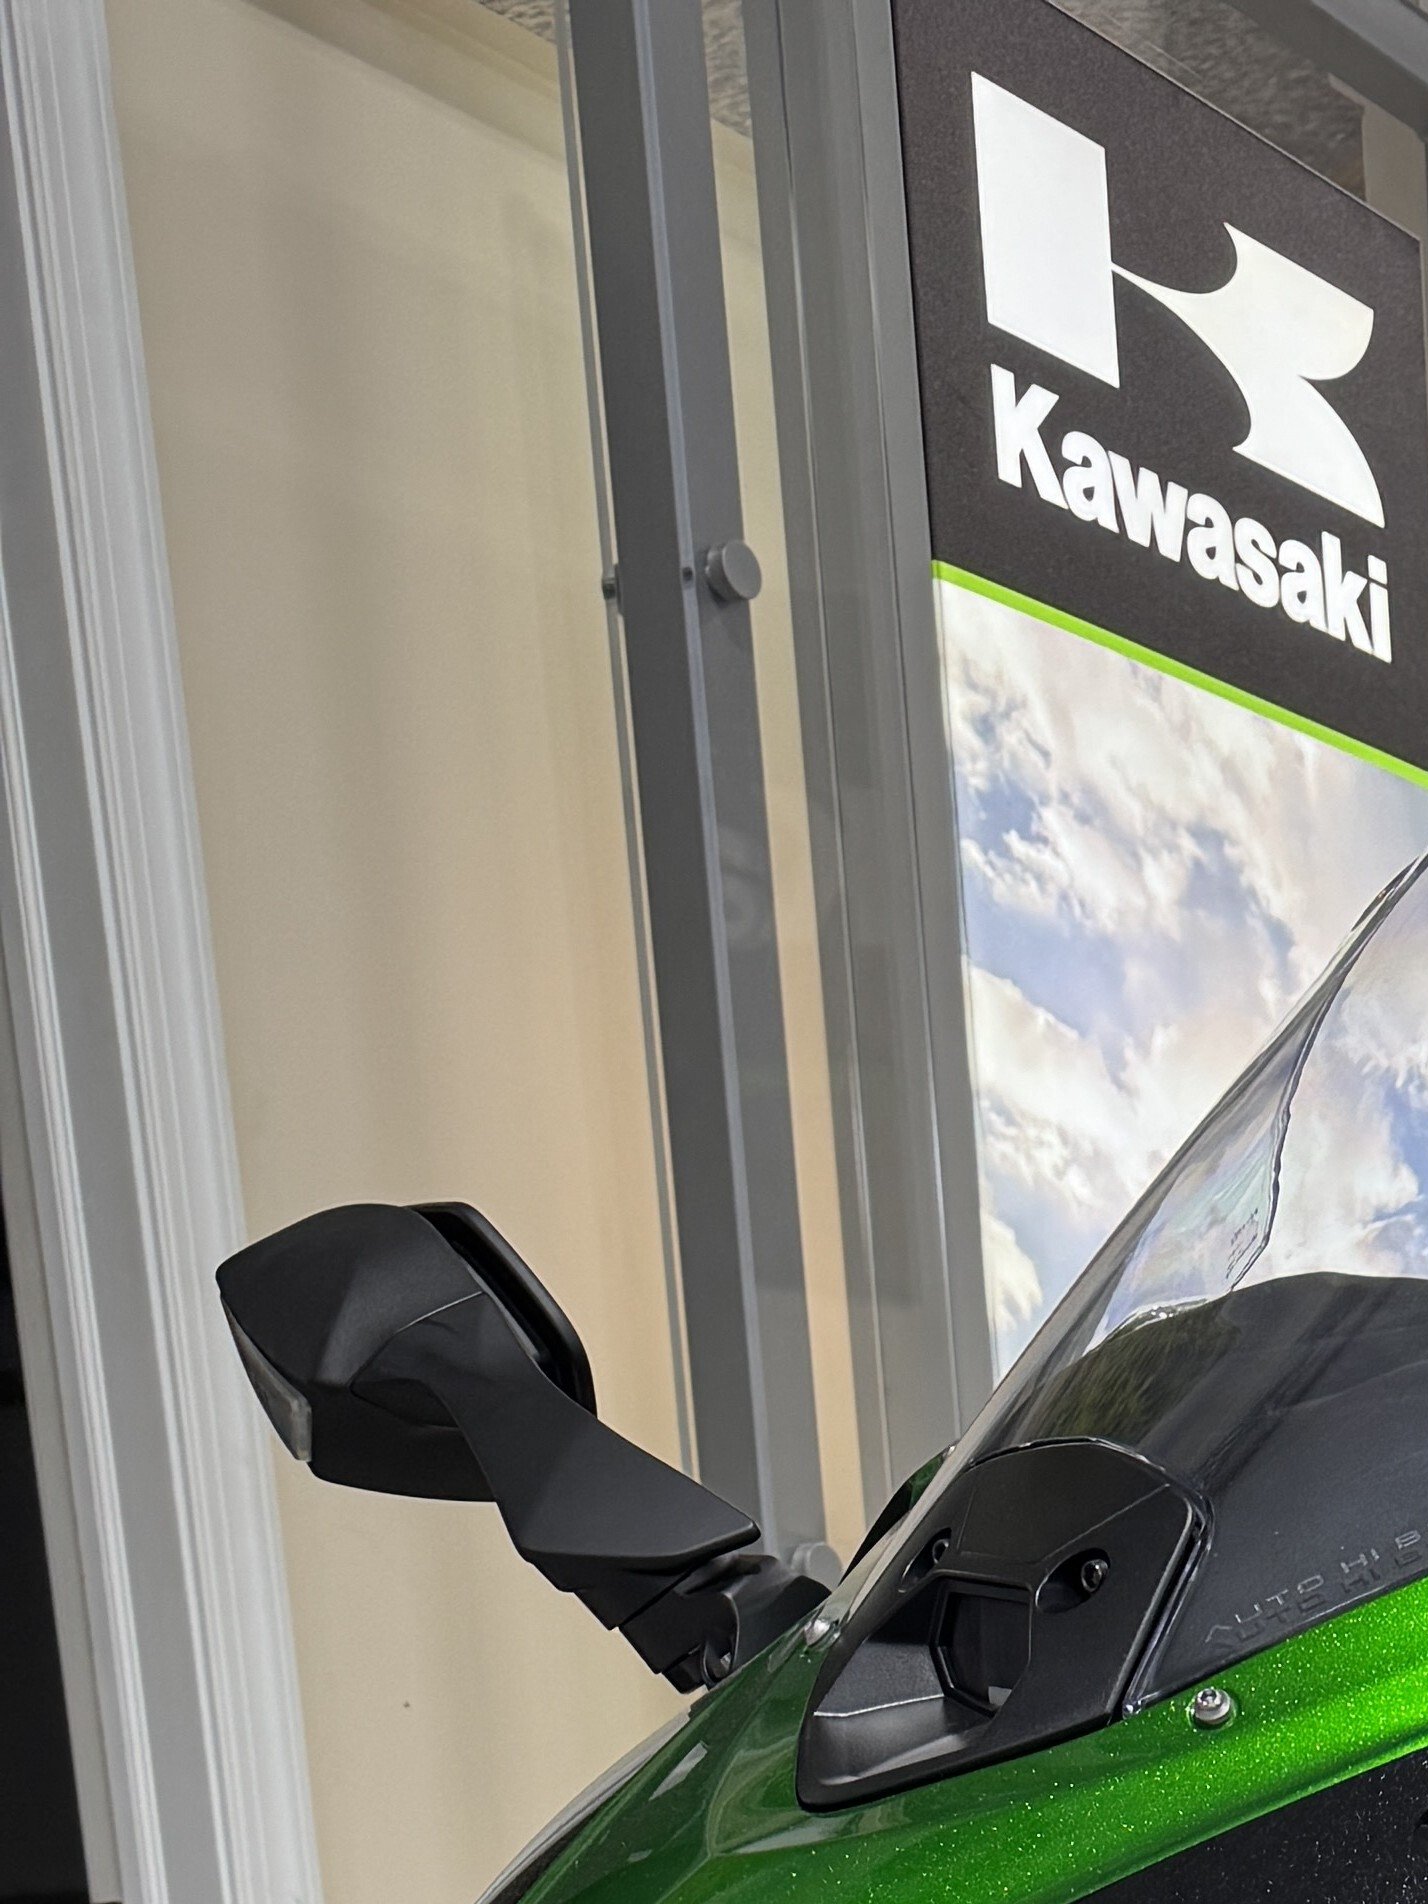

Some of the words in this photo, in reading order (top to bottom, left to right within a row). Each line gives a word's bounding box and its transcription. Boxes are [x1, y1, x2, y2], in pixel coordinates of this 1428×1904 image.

[990, 364, 1392, 663] Kawasaki
[1204, 1574, 1325, 1643] AUTO
[1340, 1548, 1380, 1574] HI
